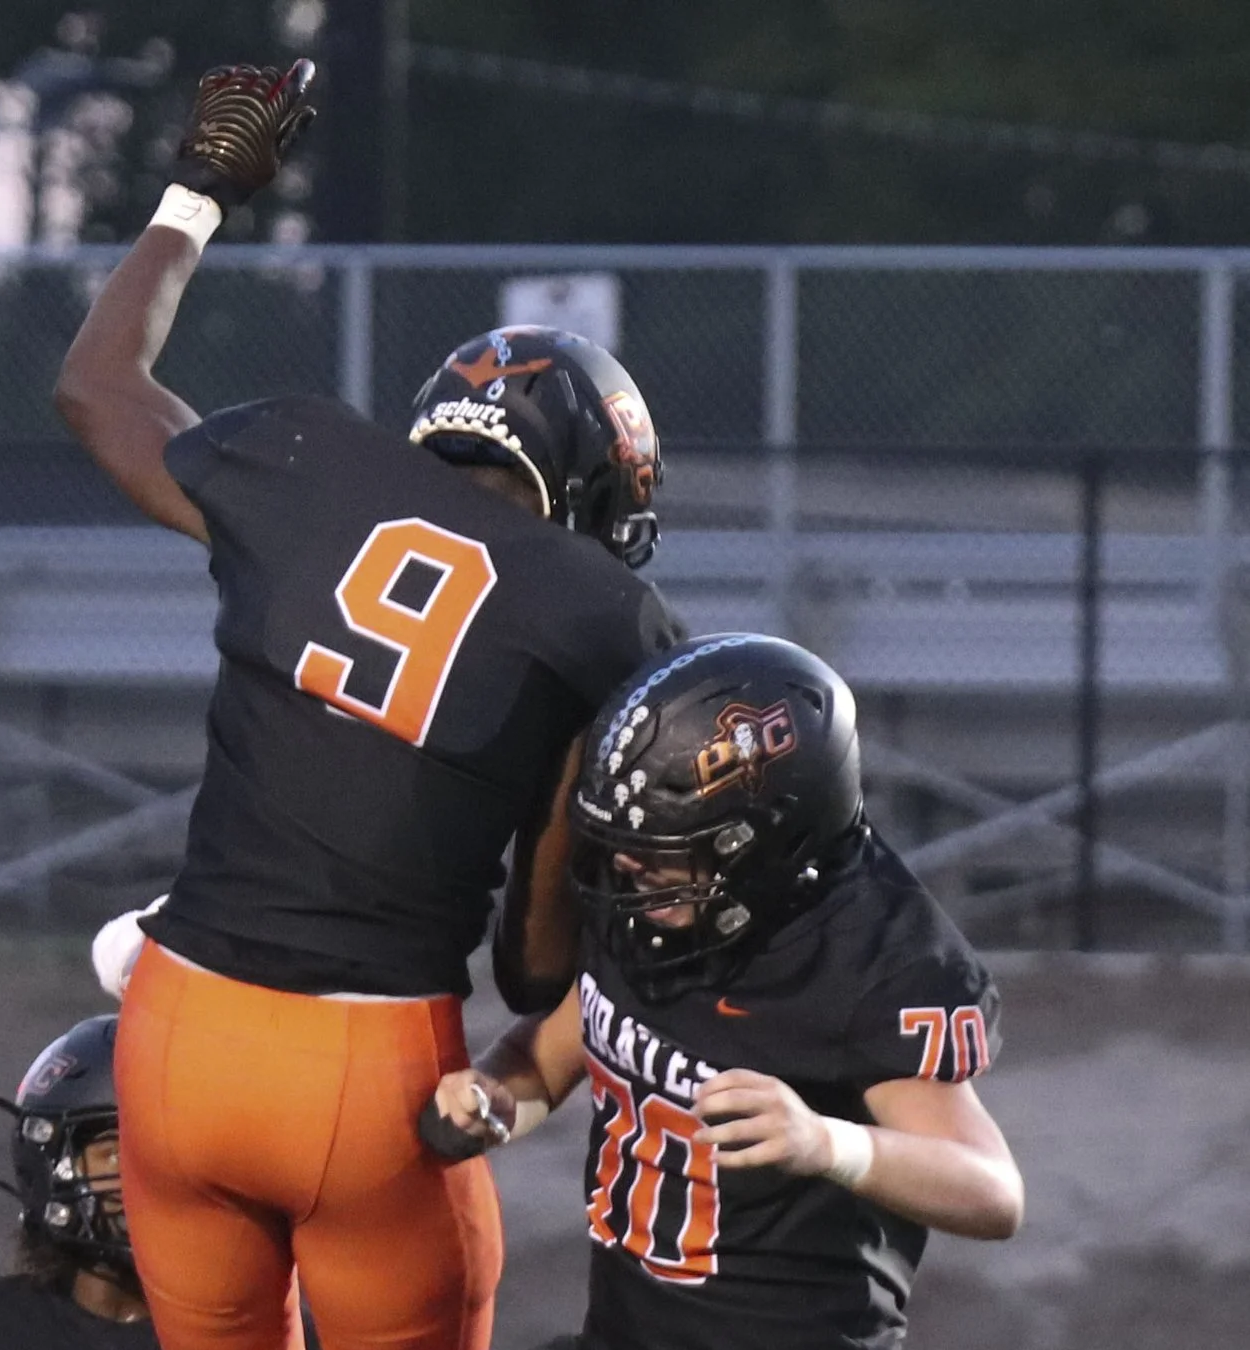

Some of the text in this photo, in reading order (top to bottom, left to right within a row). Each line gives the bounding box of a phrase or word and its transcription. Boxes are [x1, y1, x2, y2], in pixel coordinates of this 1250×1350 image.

[293, 516, 499, 748] 9
[899, 1005, 989, 1082] 70
[584, 1048, 720, 1285] 70
